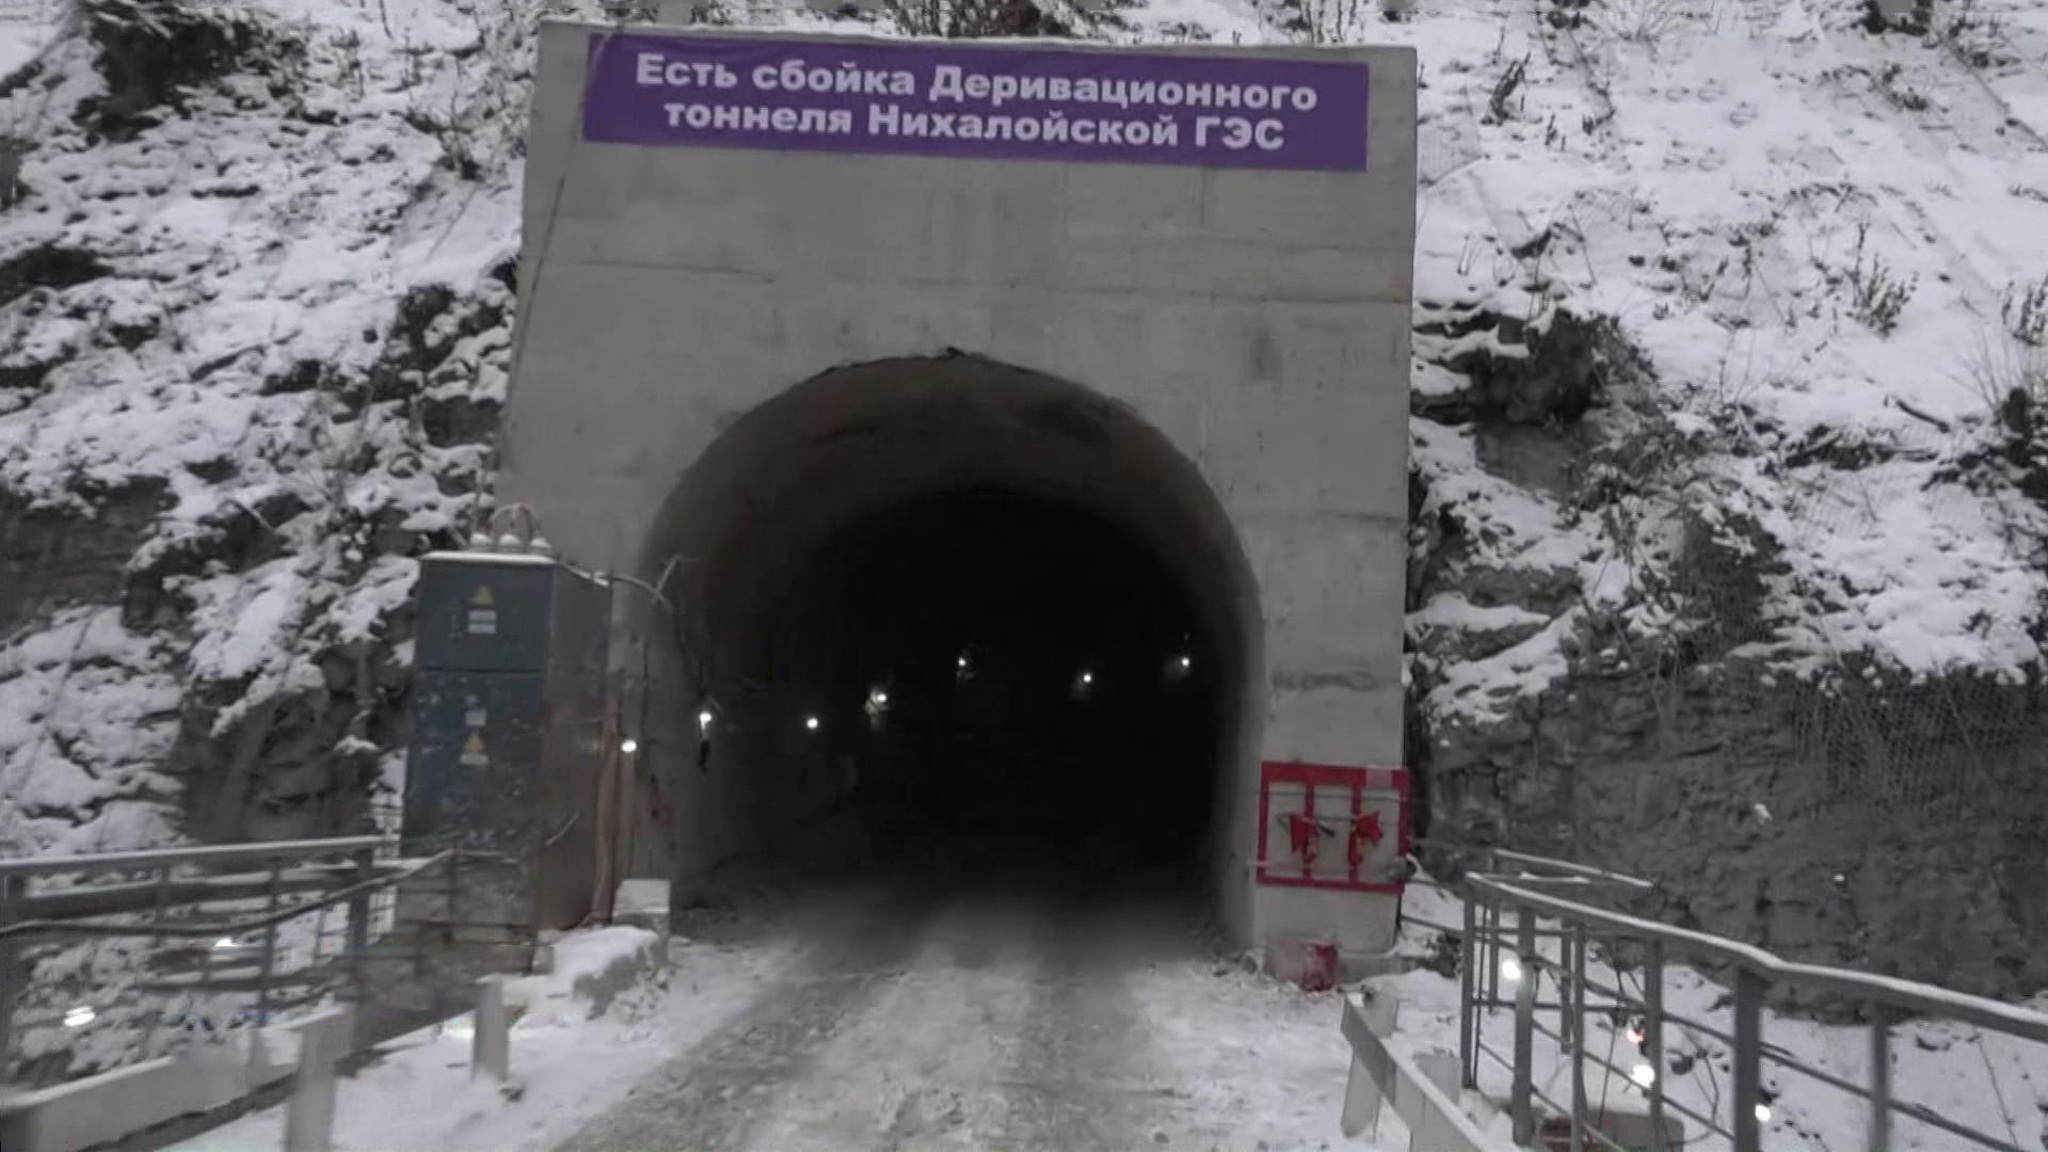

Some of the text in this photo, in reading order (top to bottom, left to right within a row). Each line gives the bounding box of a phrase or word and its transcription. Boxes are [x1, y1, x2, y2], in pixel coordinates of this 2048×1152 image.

[636, 53, 1318, 111] Есть сбойка Деривационного
[664, 103, 1284, 149] тоннеля Нихалойской ГЭС
